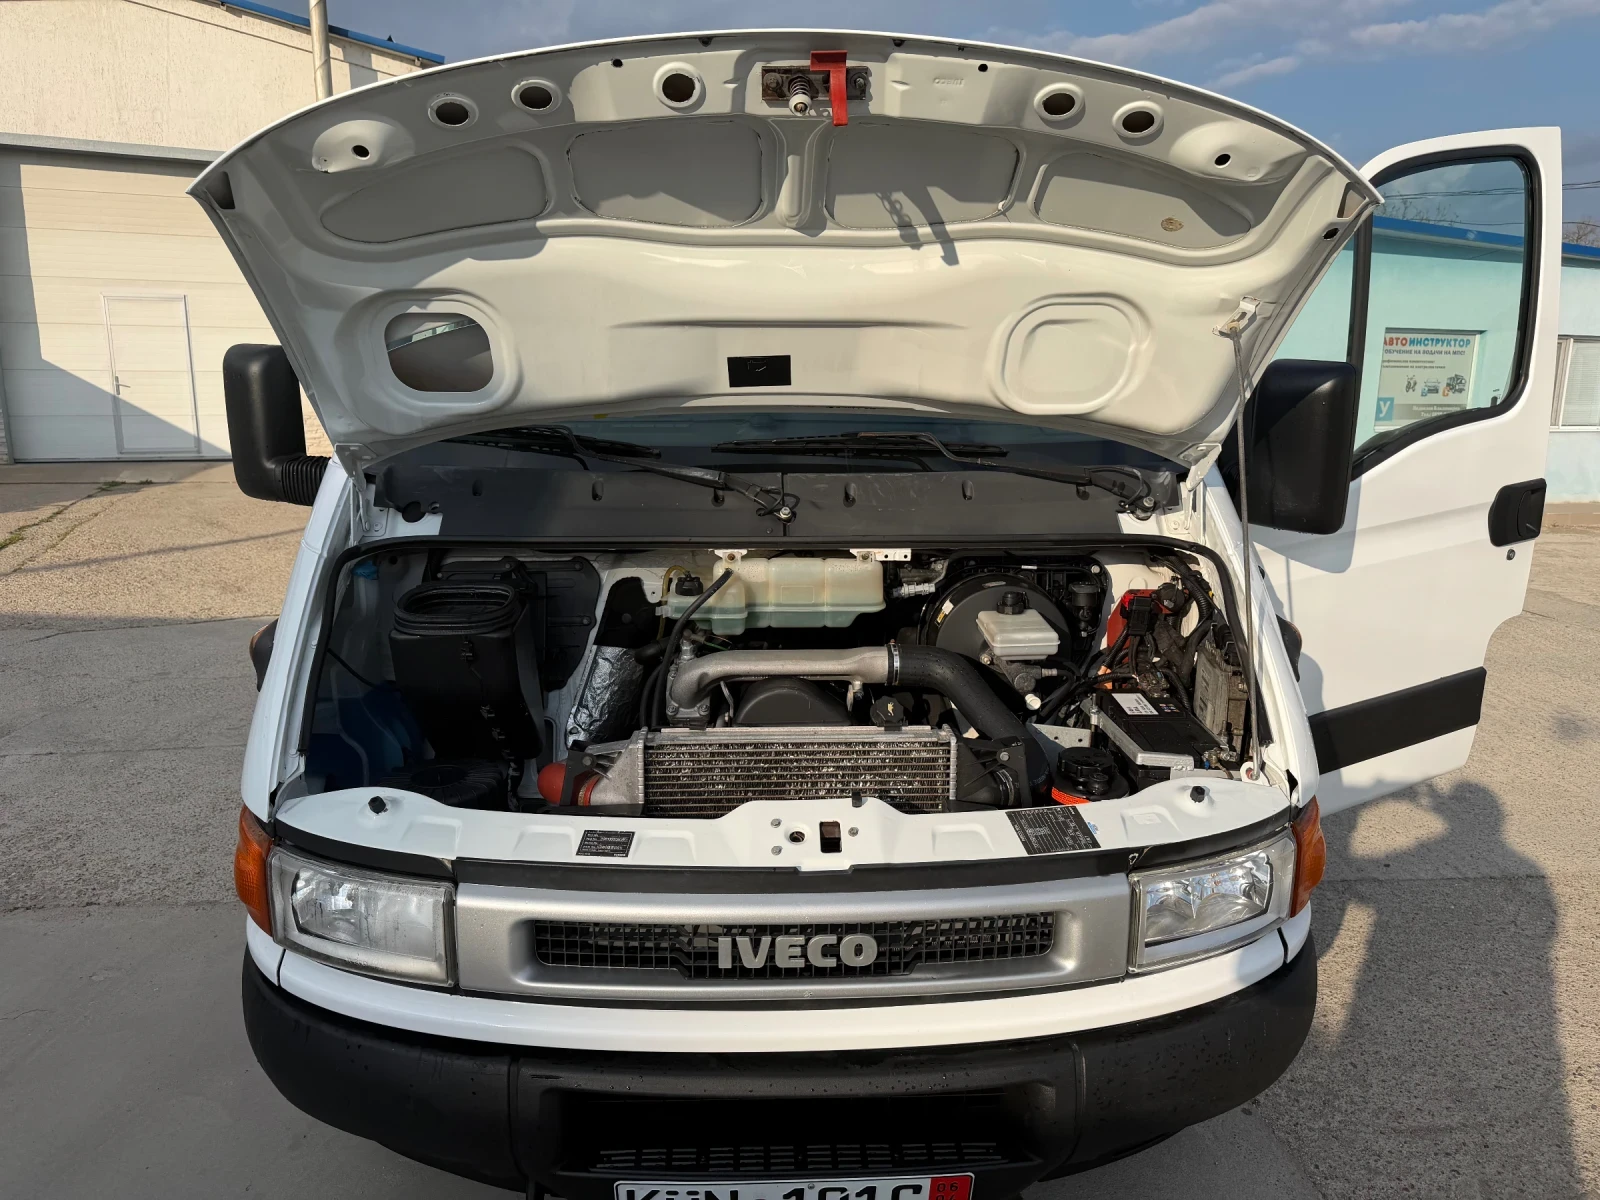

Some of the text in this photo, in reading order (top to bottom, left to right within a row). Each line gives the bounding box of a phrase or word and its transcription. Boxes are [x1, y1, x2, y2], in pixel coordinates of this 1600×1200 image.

[1383, 336, 1471, 348] АВТОИНСТРУКТОР
[718, 933, 878, 968] IVECO
[937, 1182, 959, 1193] 06
